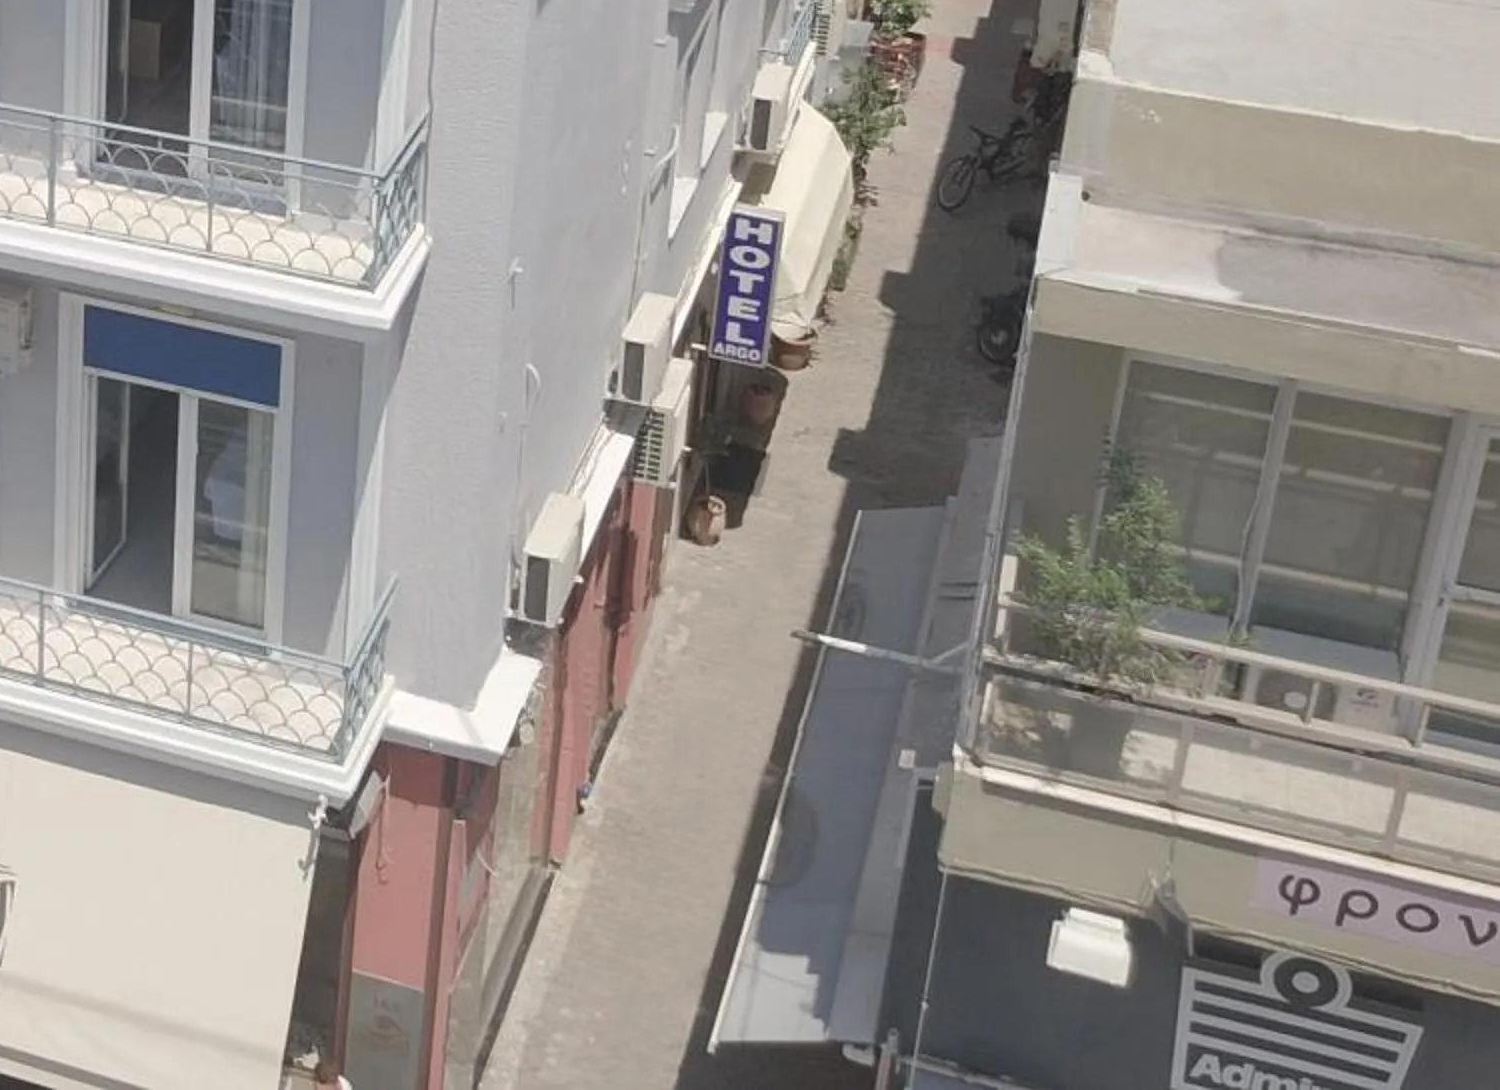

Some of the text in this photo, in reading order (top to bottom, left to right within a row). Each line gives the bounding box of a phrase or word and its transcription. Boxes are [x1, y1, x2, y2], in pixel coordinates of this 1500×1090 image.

[725, 217, 774, 346] HOTEL
[714, 341, 762, 361] ARGO
[1278, 873, 1498, 947] φρον
[1189, 1053, 1332, 1090] Adm
